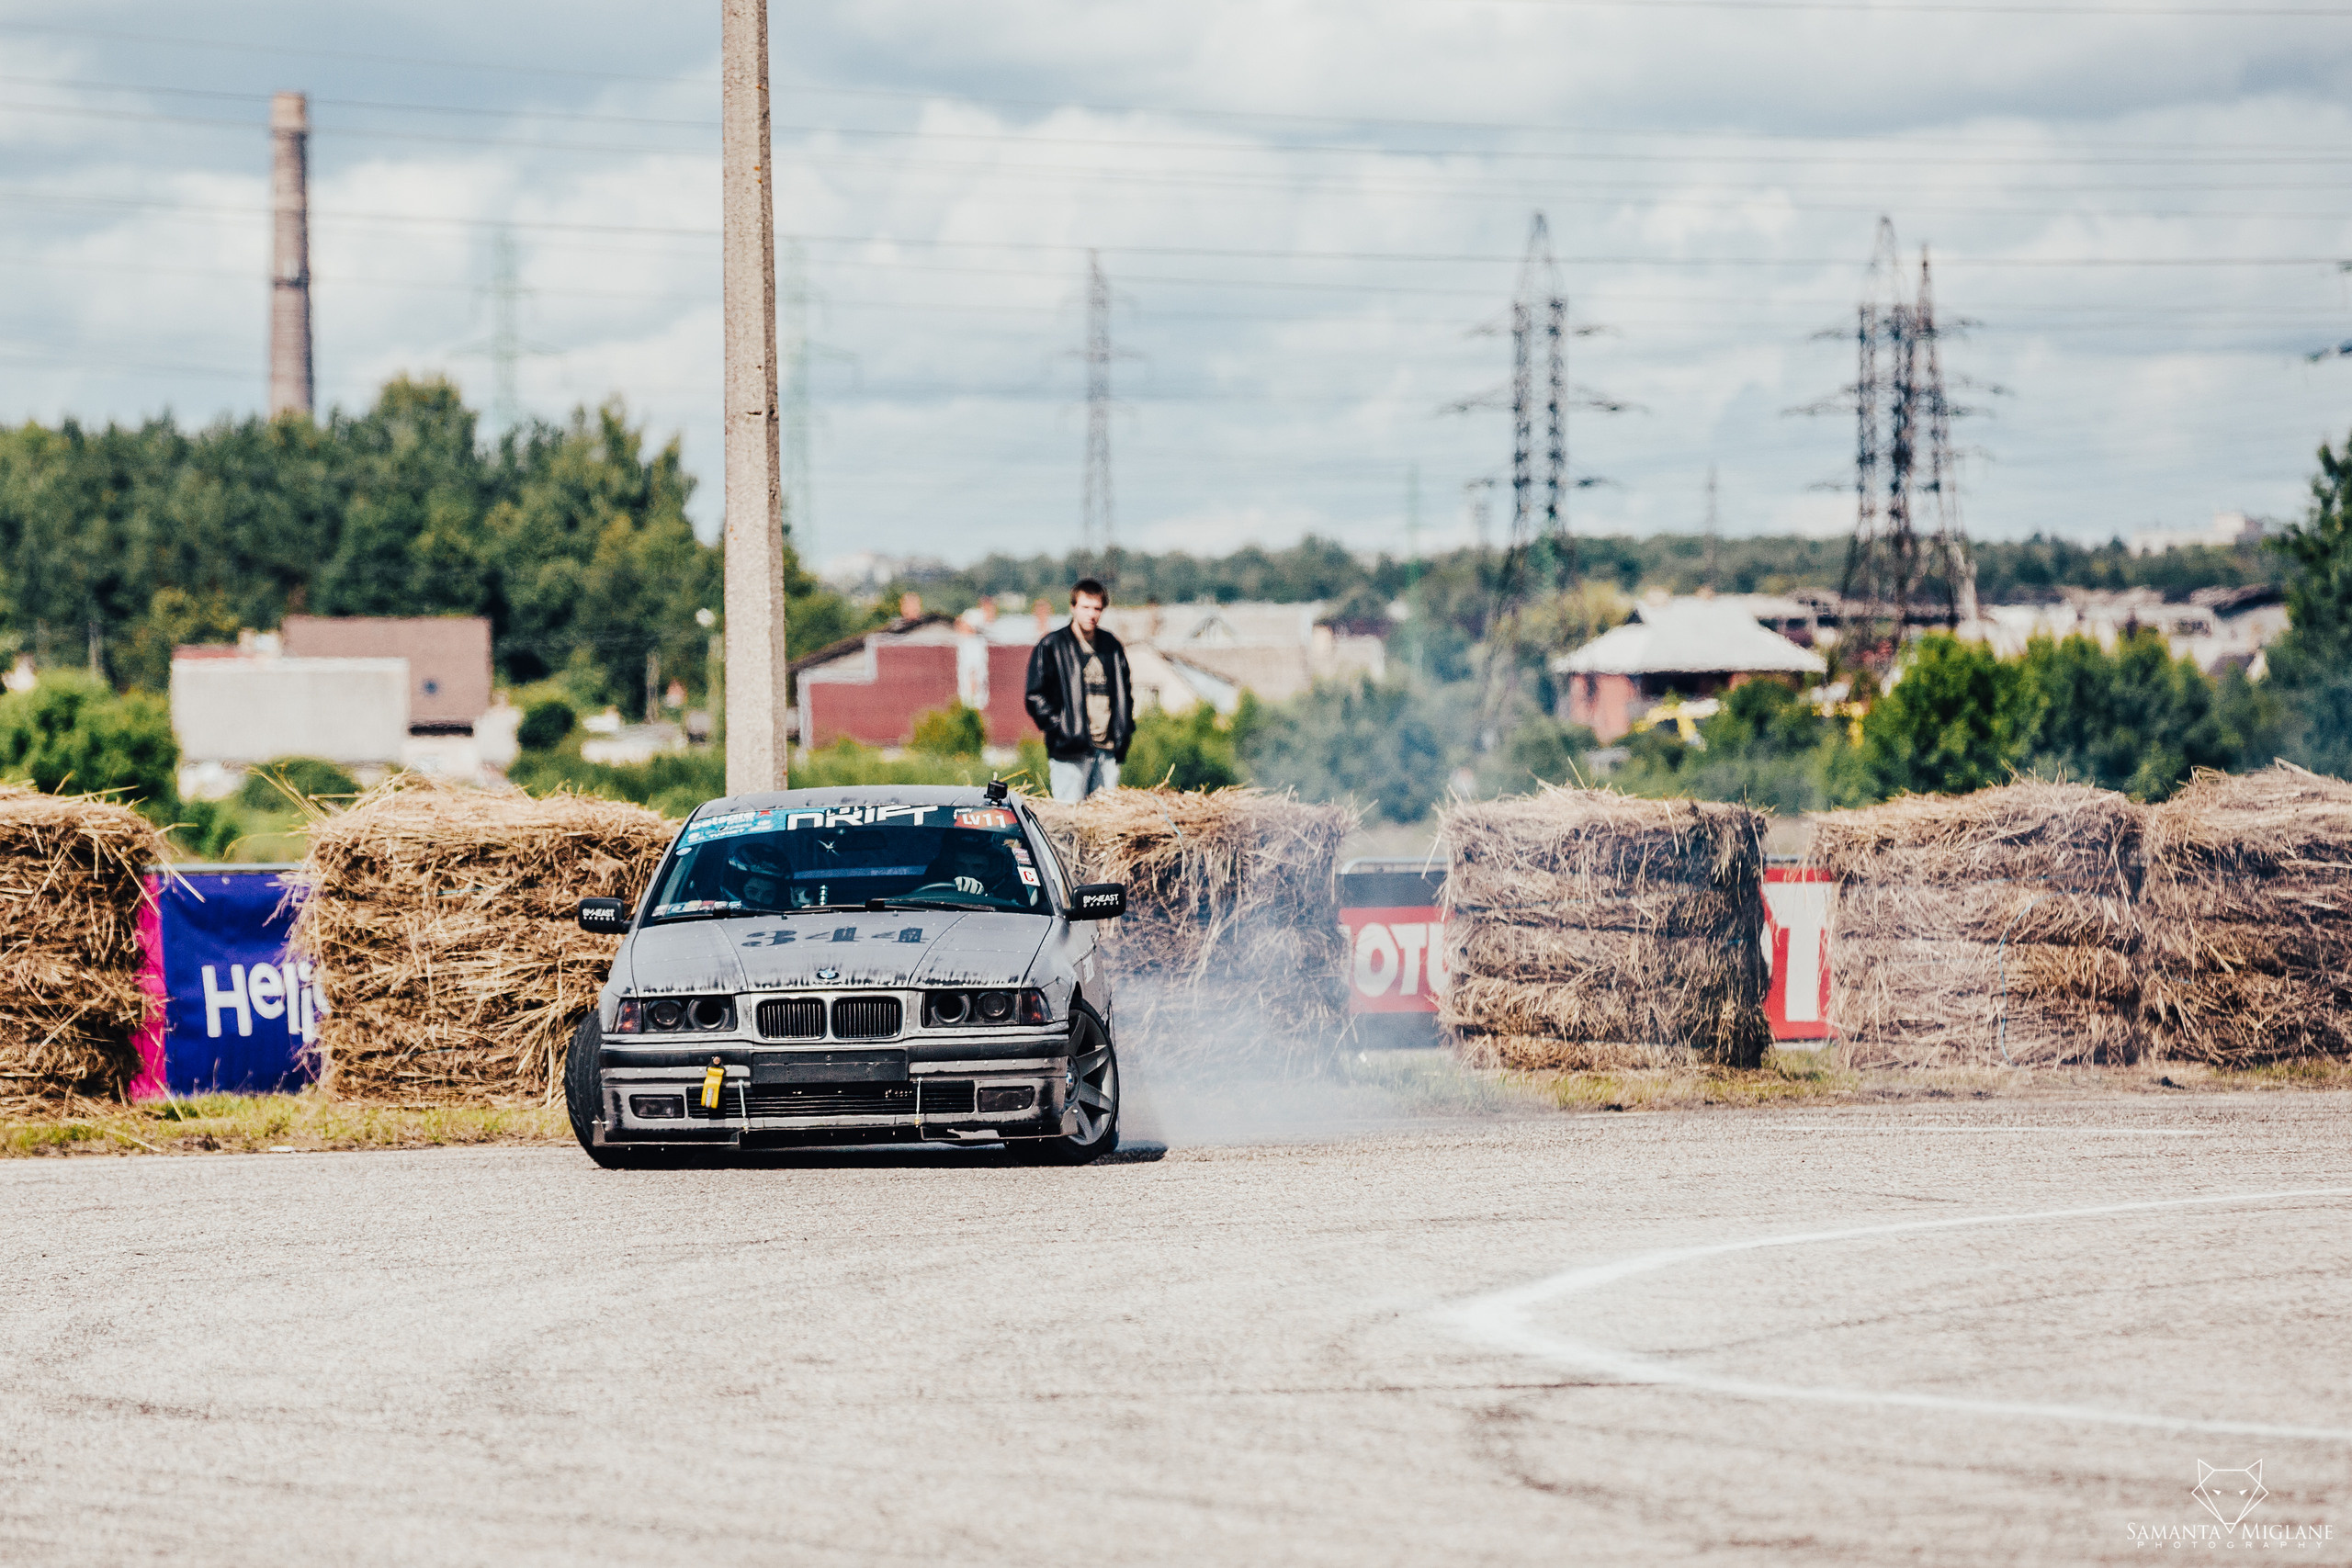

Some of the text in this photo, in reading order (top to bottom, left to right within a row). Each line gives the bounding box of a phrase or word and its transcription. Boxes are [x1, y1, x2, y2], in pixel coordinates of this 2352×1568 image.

[1023, 870, 1035, 883] C
[741, 926, 931, 947] 344
[1337, 921, 1452, 998] OTU
